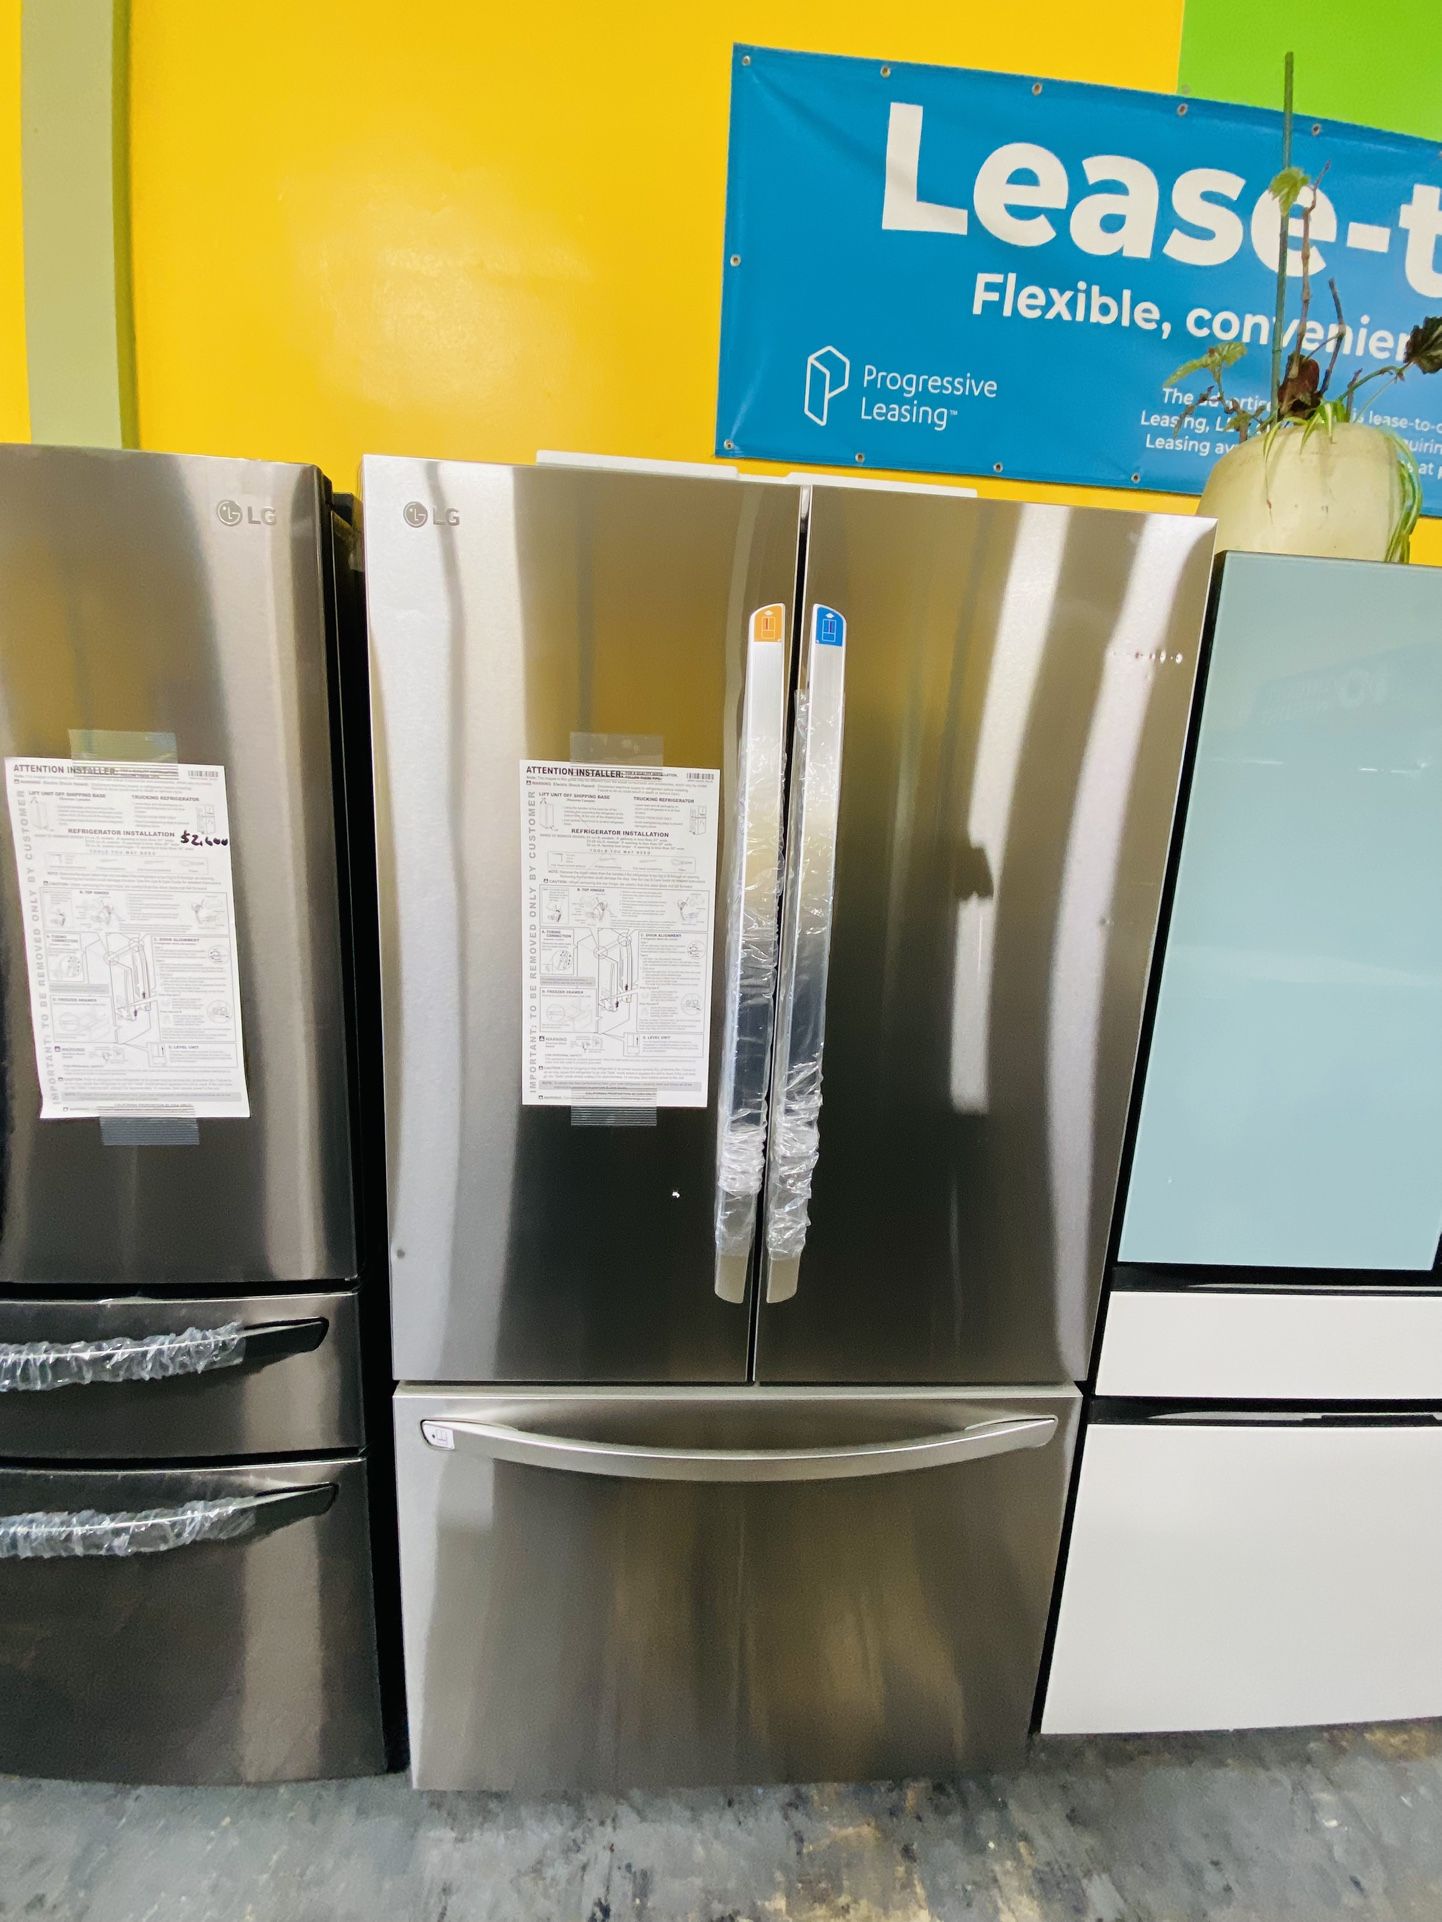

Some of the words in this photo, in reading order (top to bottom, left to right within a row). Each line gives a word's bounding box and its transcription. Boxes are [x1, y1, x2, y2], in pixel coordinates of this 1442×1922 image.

[972, 272, 1172, 339] Flexible,
[863, 364, 998, 397] Progressive
[1162, 388, 1193, 405] The
[1140, 410, 1209, 433] Leasng,
[1145, 433, 1210, 456] Leasing
[247, 506, 277, 526] LG
[433, 507, 460, 527] LG
[13, 764, 64, 774] ATTENTION
[526, 766, 574, 776] ATTENTION
[576, 768, 624, 778] INSTALLER:
[17, 790, 33, 860] CUSTOMER
[68, 828, 121, 836] REFRIGERATOR
[527, 791, 536, 859] CUSTOMER
[571, 828, 621, 836] REFRIGERATOR
[622, 830, 670, 838] INSTALLATION
[26, 867, 36, 883] BY
[528, 865, 537, 881] BY
[29, 890, 39, 922] ONLY
[529, 887, 537, 918] ONLY
[529, 924, 537, 979] REMOVED
[529, 985, 537, 999] BE
[41, 1014, 49, 1029] TO
[529, 1005, 537, 1019] TO
[529, 1025, 537, 1093] IMPORTANT:
